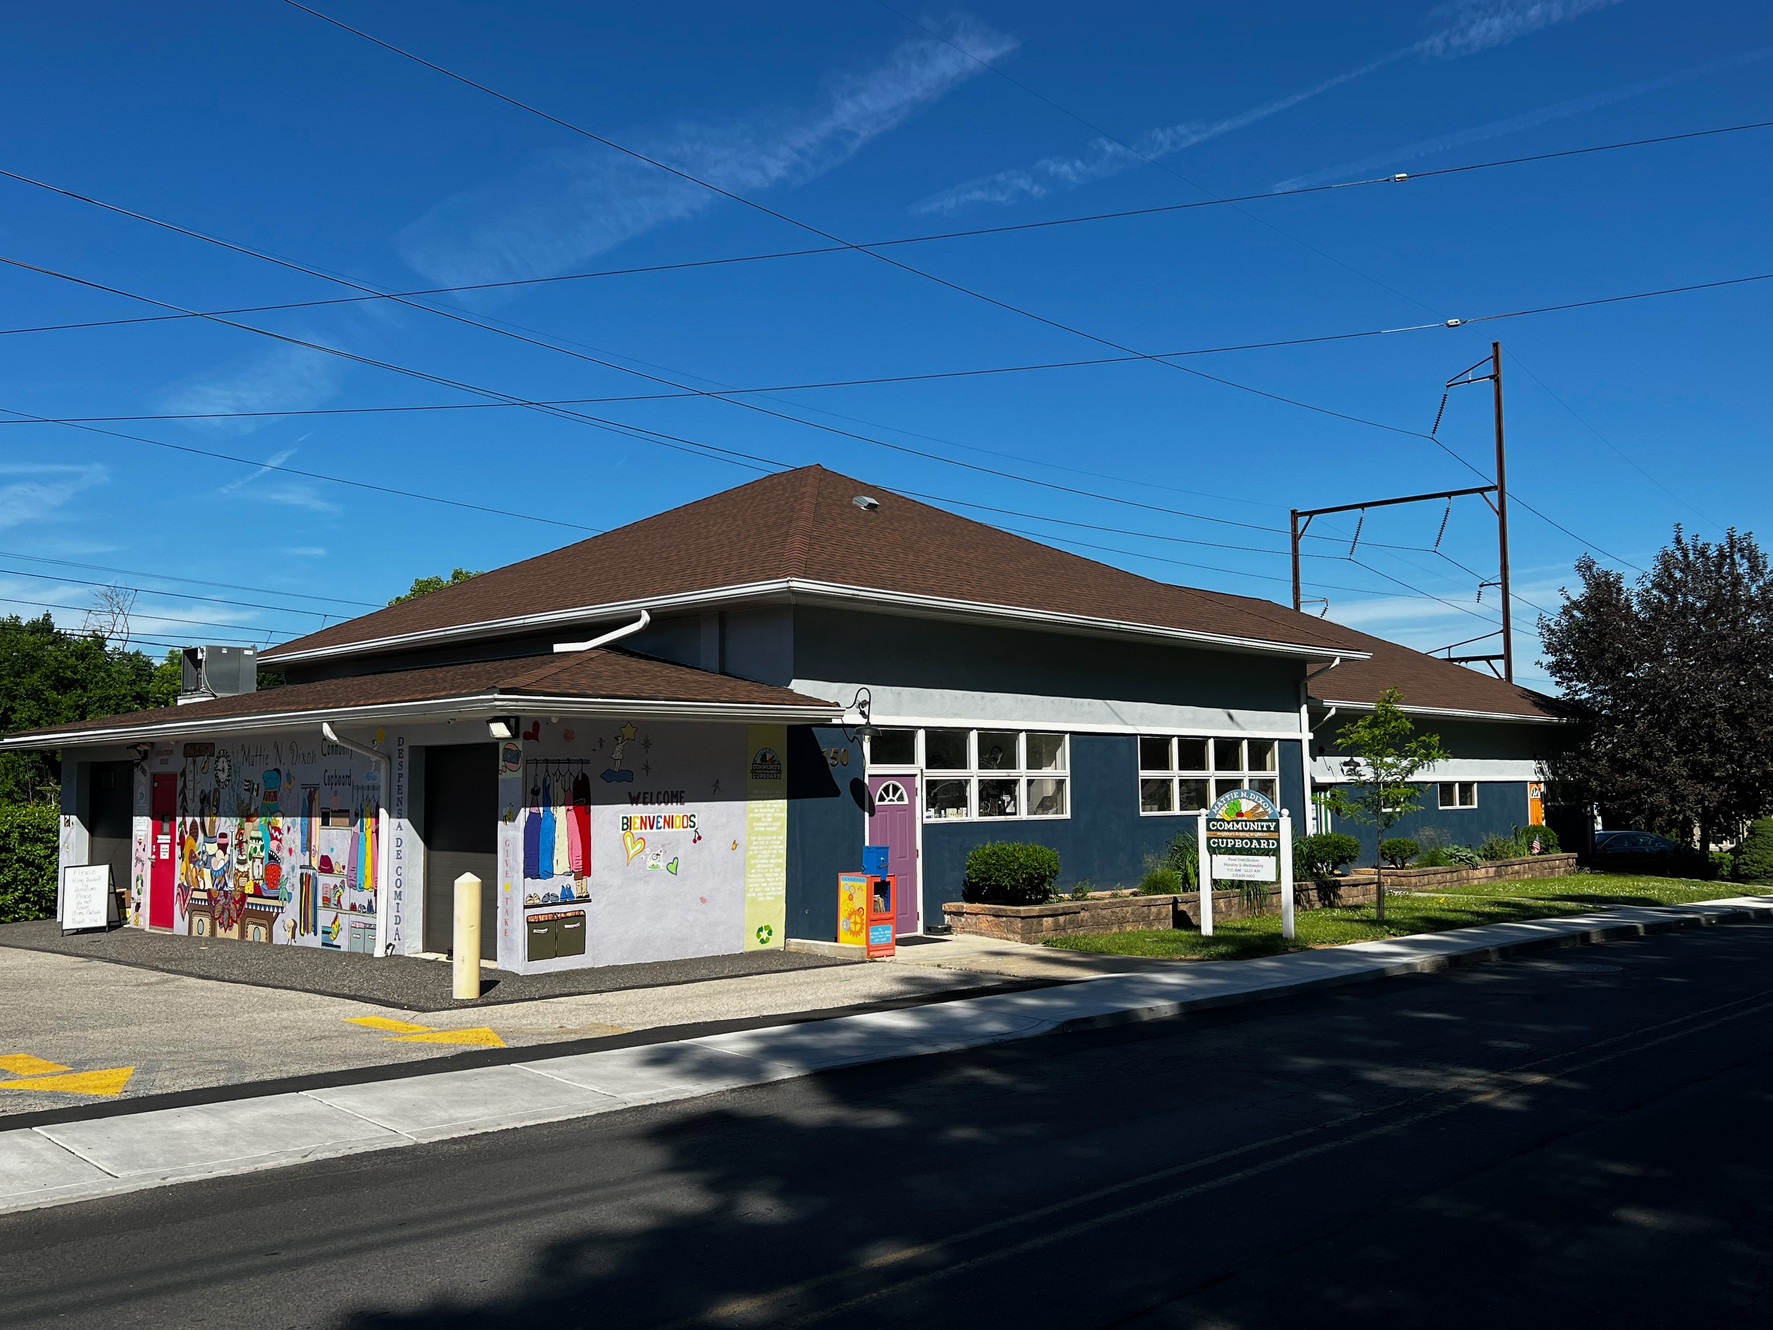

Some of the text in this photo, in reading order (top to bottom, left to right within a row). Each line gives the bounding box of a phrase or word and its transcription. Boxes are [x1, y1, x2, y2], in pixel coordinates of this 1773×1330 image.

[241, 740, 317, 767] Mattie N. Dixon
[628, 790, 686, 807] WELCOME
[1212, 791, 1274, 814] MATTIE N. DIXON
[621, 814, 696, 832] BIENVENIDOS
[1209, 821, 1277, 831] COMMUNITY
[393, 736, 406, 942] DESPENSA DE COMIDA
[1210, 838, 1277, 848] CUPBOARD
